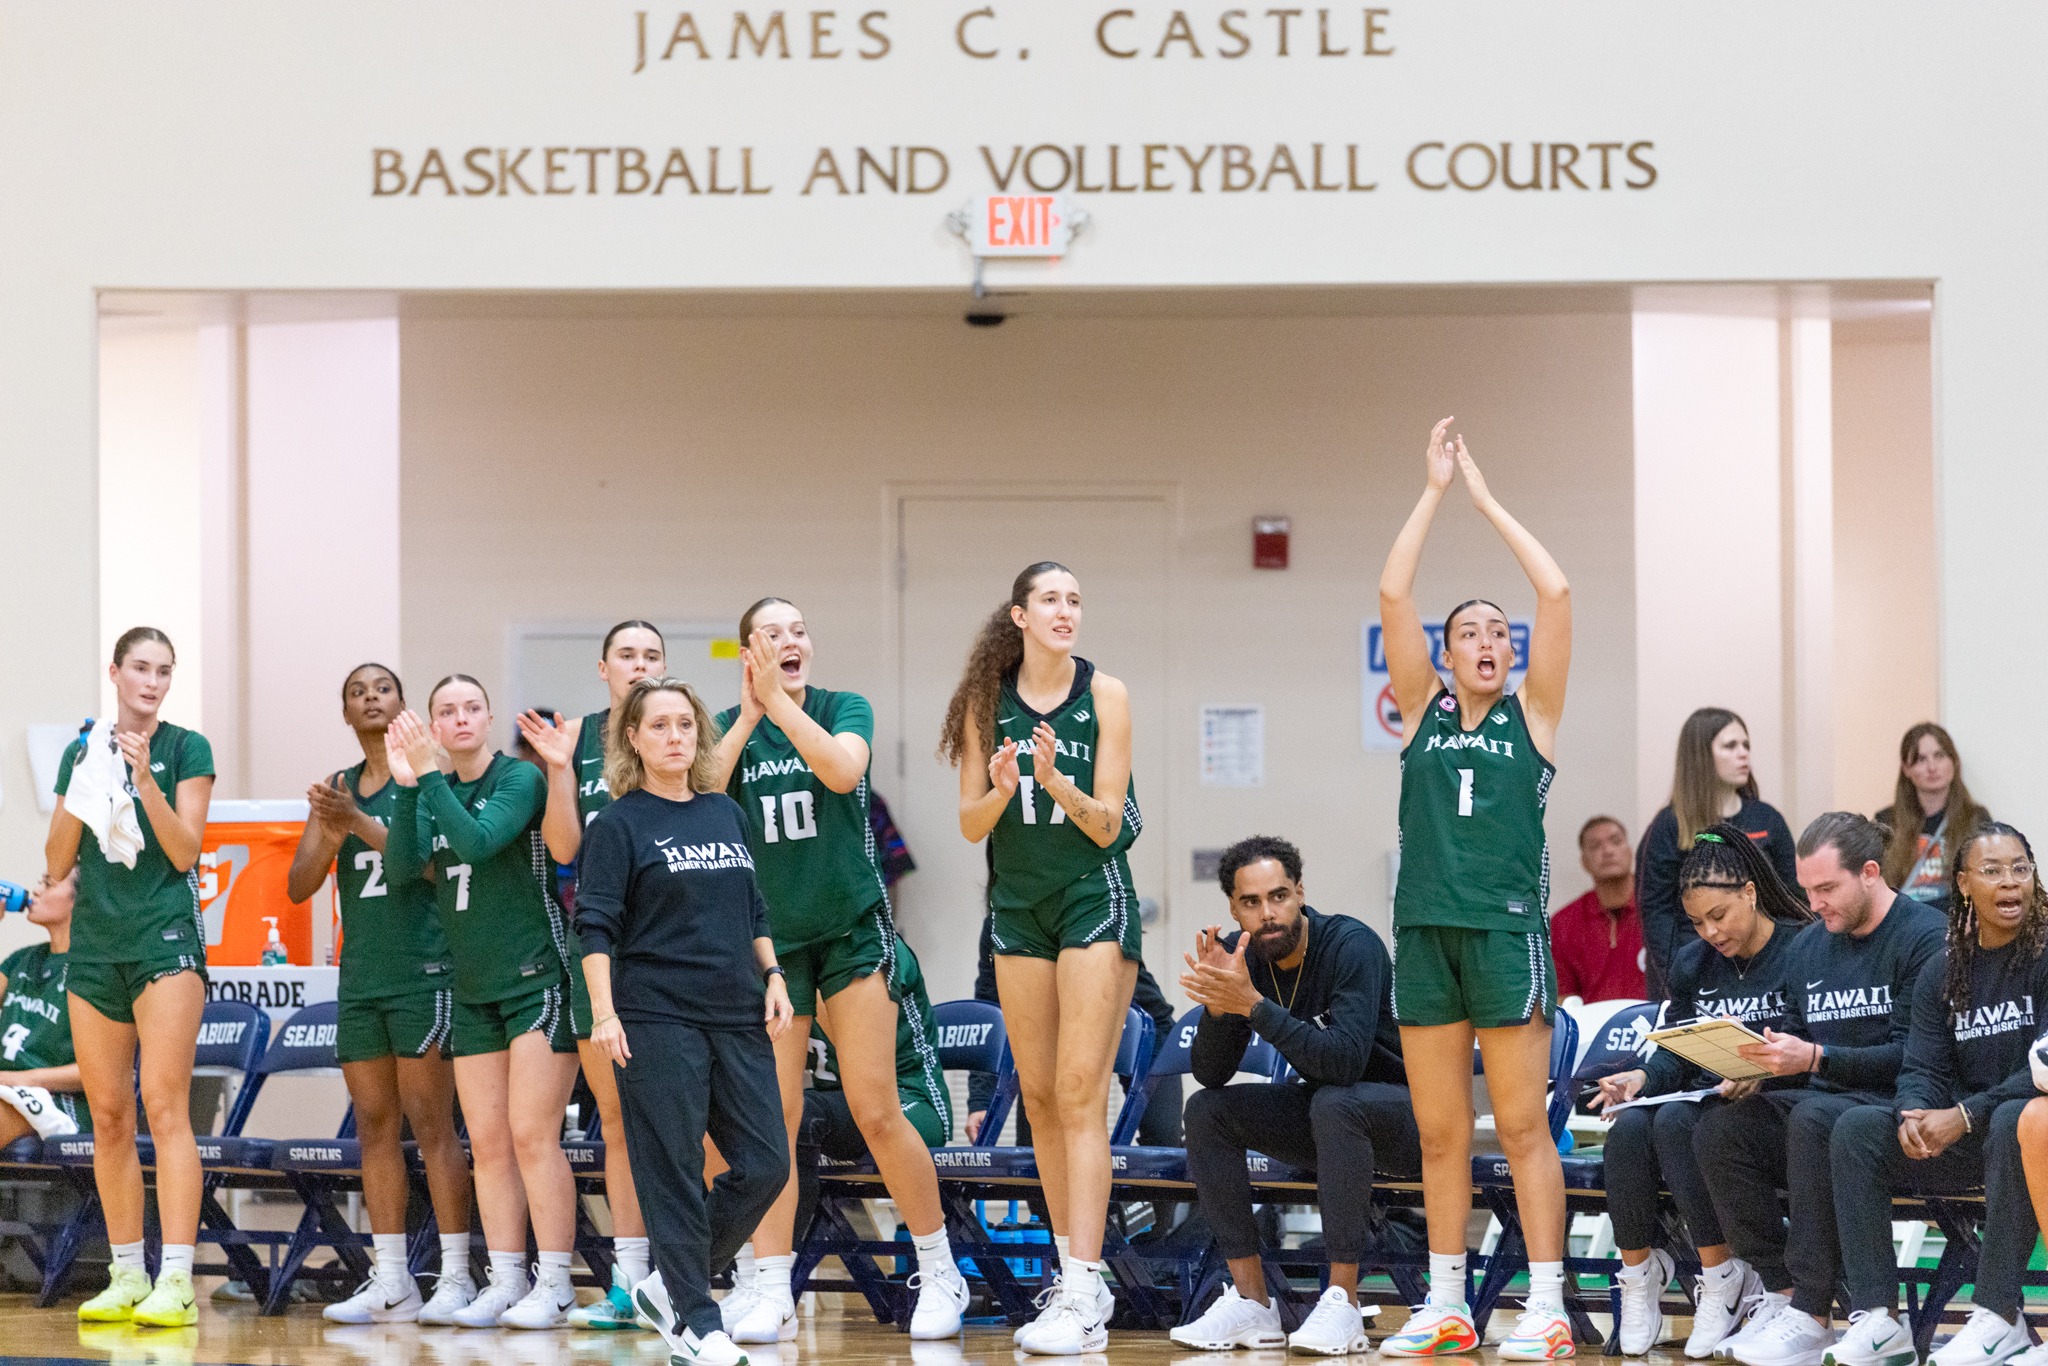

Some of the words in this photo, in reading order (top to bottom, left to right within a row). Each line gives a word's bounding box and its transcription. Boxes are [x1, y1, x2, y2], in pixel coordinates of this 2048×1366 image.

[633, 10, 892, 74] JAMES
[955, 7, 1030, 61] C.
[1095, 8, 1395, 60] CASTLE
[371, 146, 773, 196] BASKETBALL
[800, 146, 950, 195] AND
[979, 144, 1378, 194] VOLLEYBALL
[1405, 141, 1658, 192] COURTS
[987, 197, 1055, 247] EXIT
[759, 790, 818, 844] 10
[1457, 768, 1475, 817] 1
[353, 850, 388, 899] 2
[446, 863, 473, 912] 7
[2, 1022, 31, 1062] 4
[289, 1146, 342, 1161] SPARTANS
[933, 1151, 991, 1167] SPARTANS
